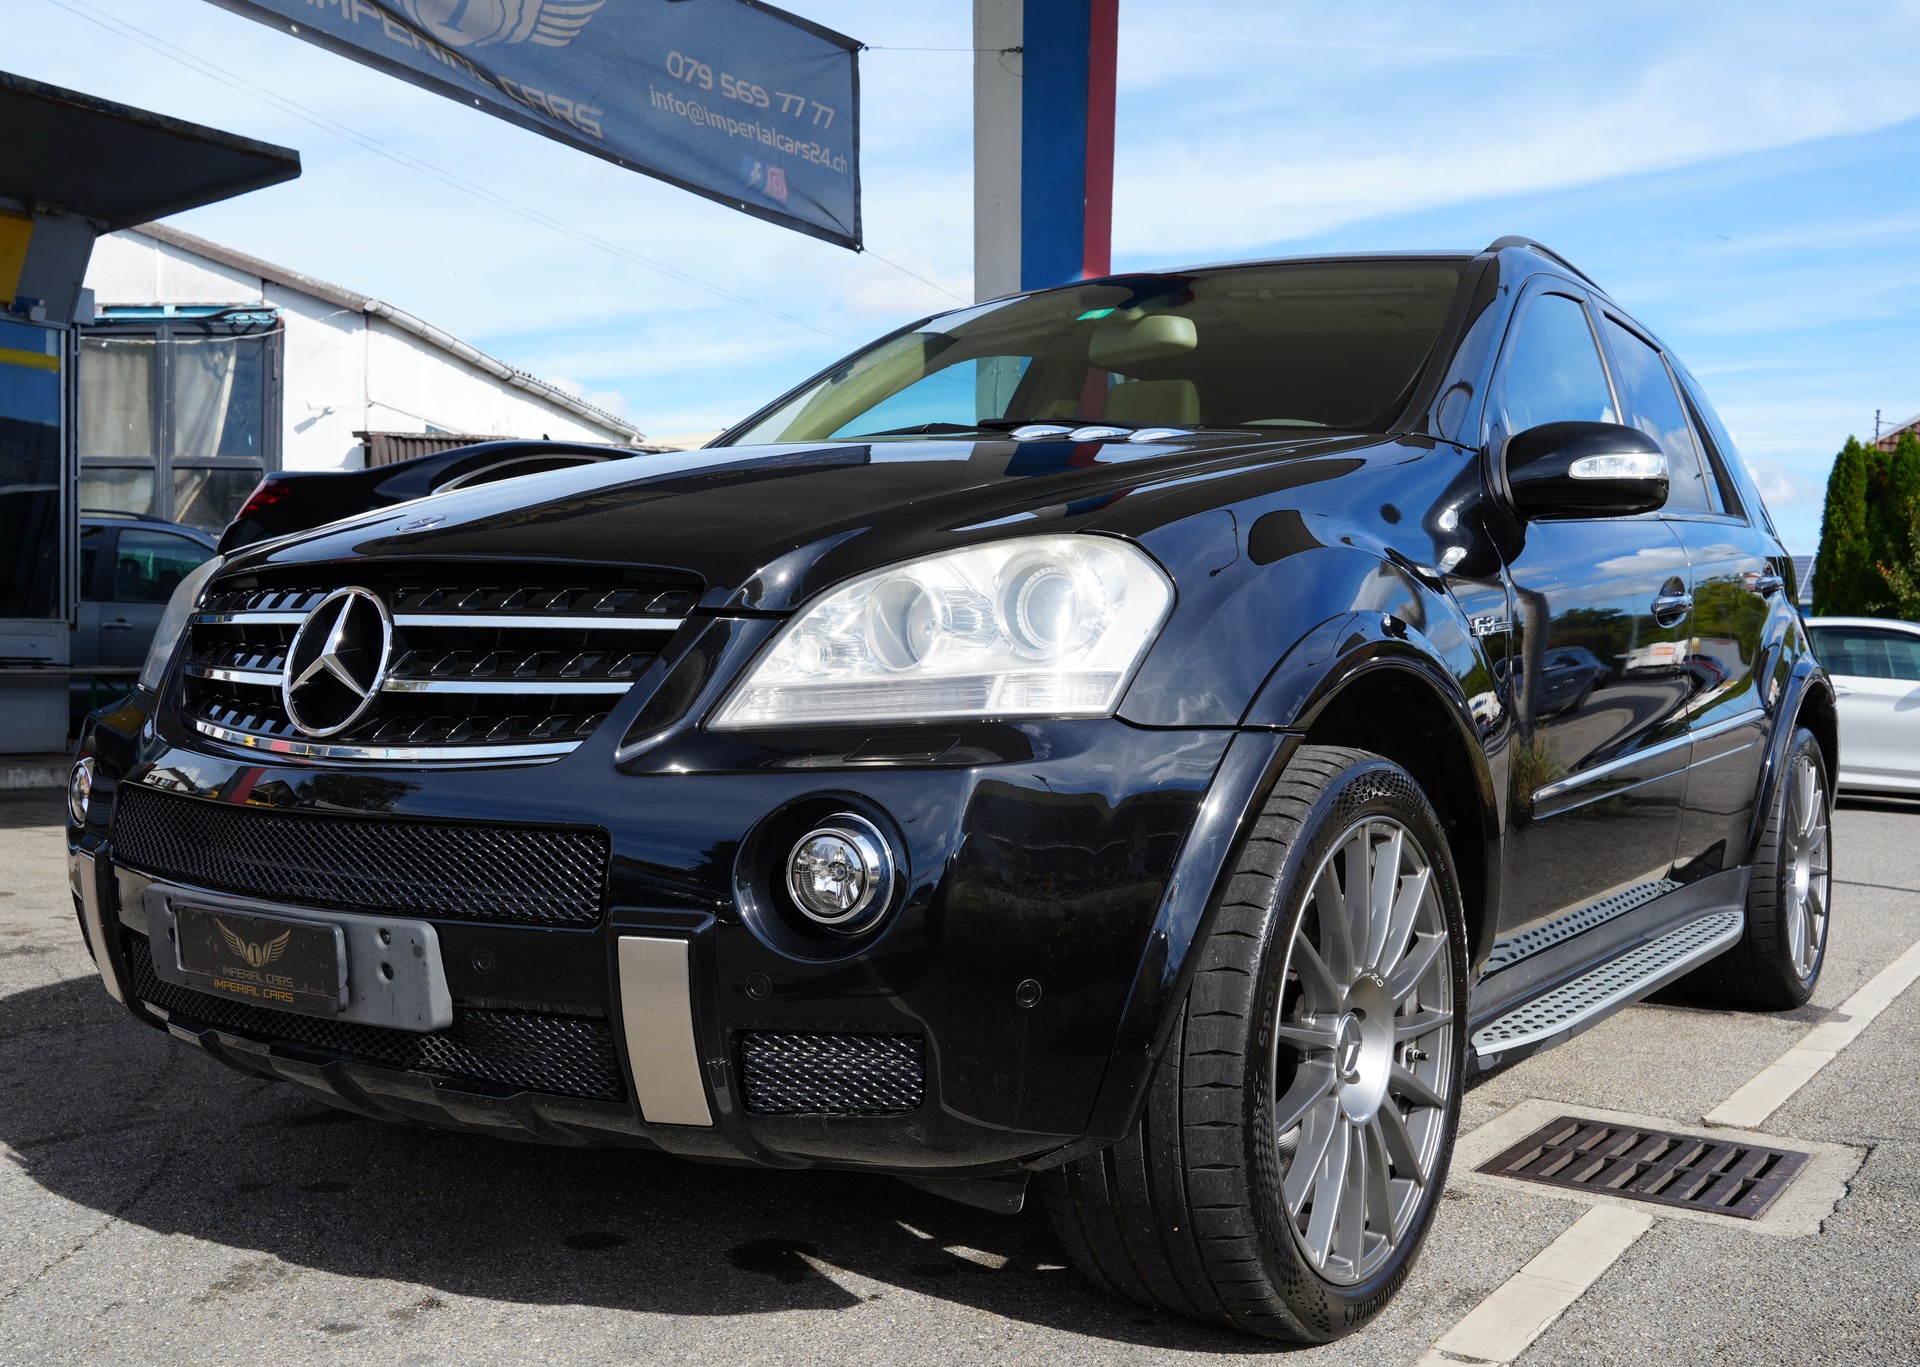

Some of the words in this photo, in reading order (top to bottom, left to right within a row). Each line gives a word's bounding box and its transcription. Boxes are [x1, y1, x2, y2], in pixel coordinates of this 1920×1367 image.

[497, 74, 604, 139] CARS
[666, 51, 713, 90] 079
[720, 73, 770, 109] 569
[775, 91, 806, 118] 77
[811, 100, 835, 129] 77
[649, 84, 849, 176] info@imperialcars24.ch
[214, 979, 260, 997] IMPERIAL
[262, 988, 294, 1003] CARS
[223, 966, 263, 982] IMPERIAL
[265, 973, 294, 988] CARS
